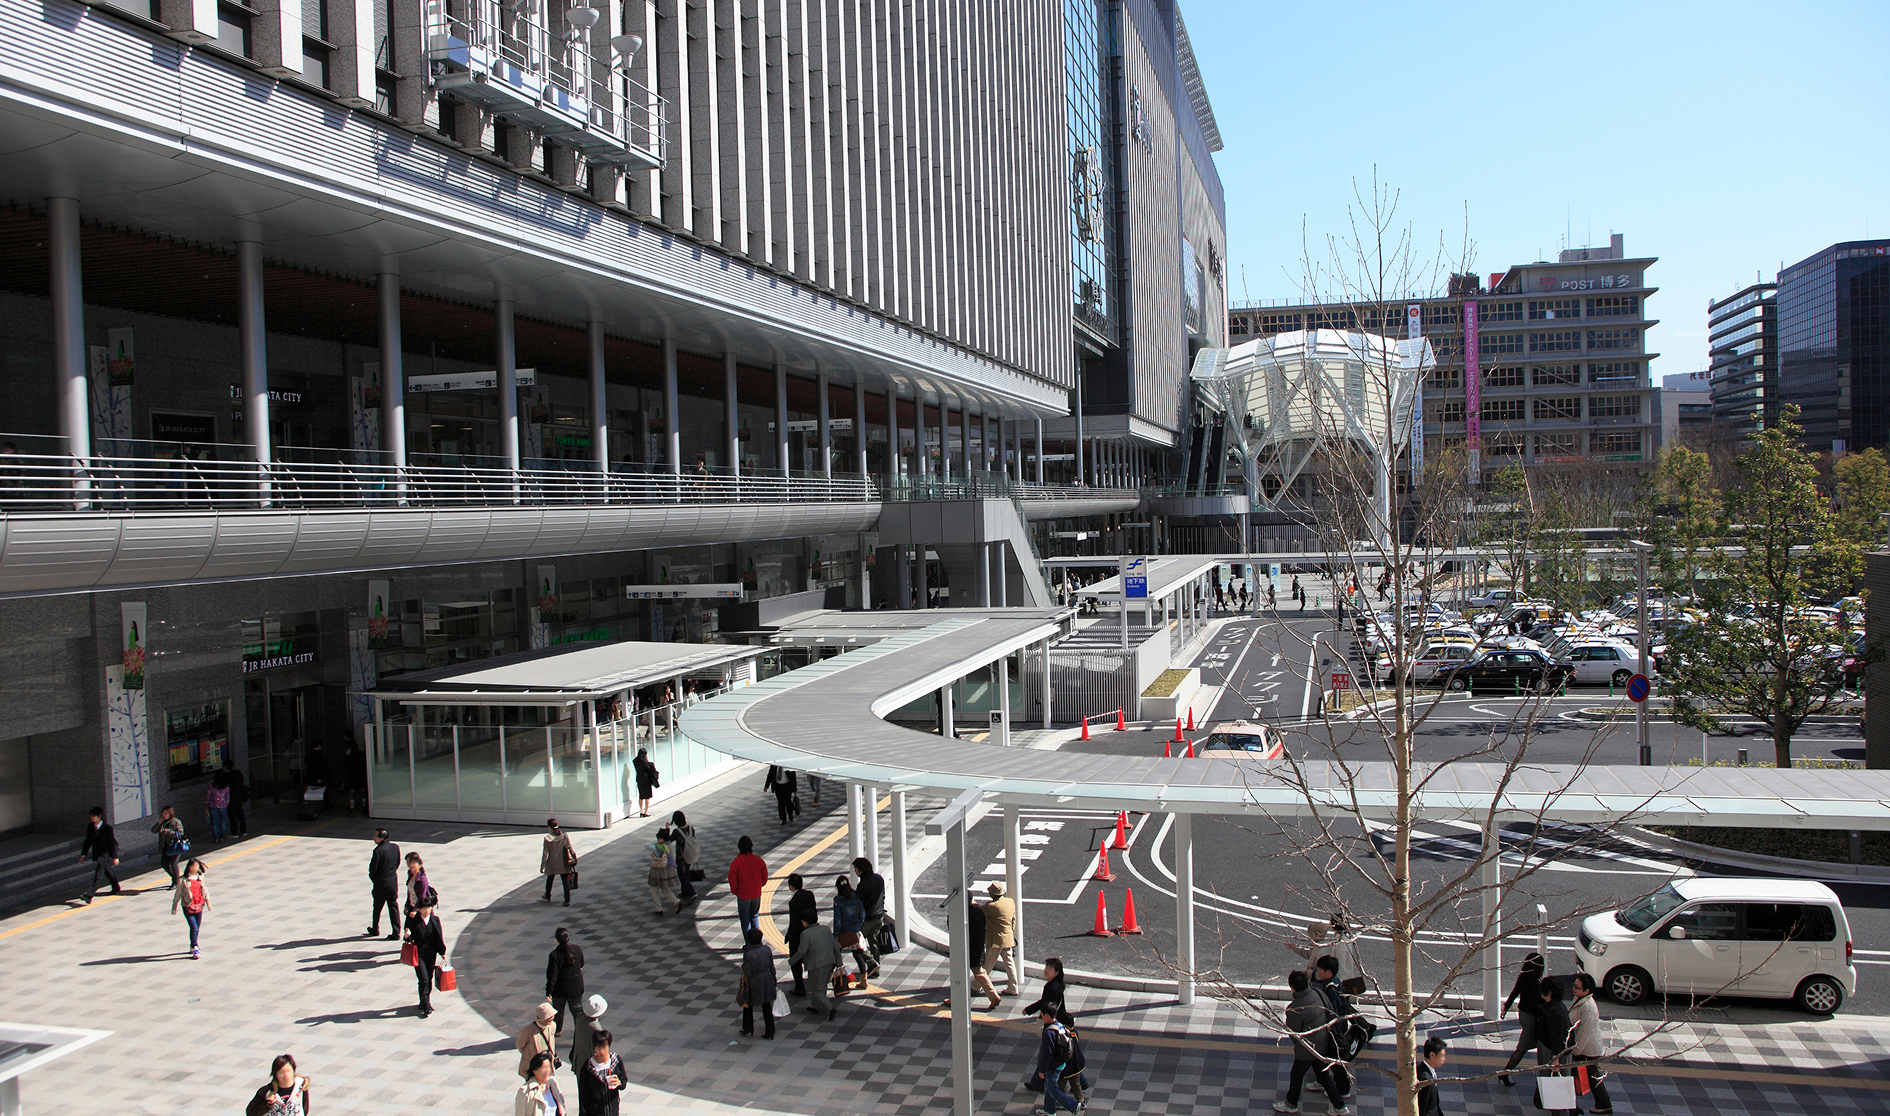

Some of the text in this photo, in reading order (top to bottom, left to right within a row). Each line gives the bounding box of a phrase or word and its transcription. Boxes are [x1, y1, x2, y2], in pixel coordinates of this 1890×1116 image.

[1561, 280, 1595, 290] POST
[1600, 274, 1630, 288] 博多
[282, 392, 302, 403] CITY
[248, 652, 314, 672] JR HAKATA CITY
